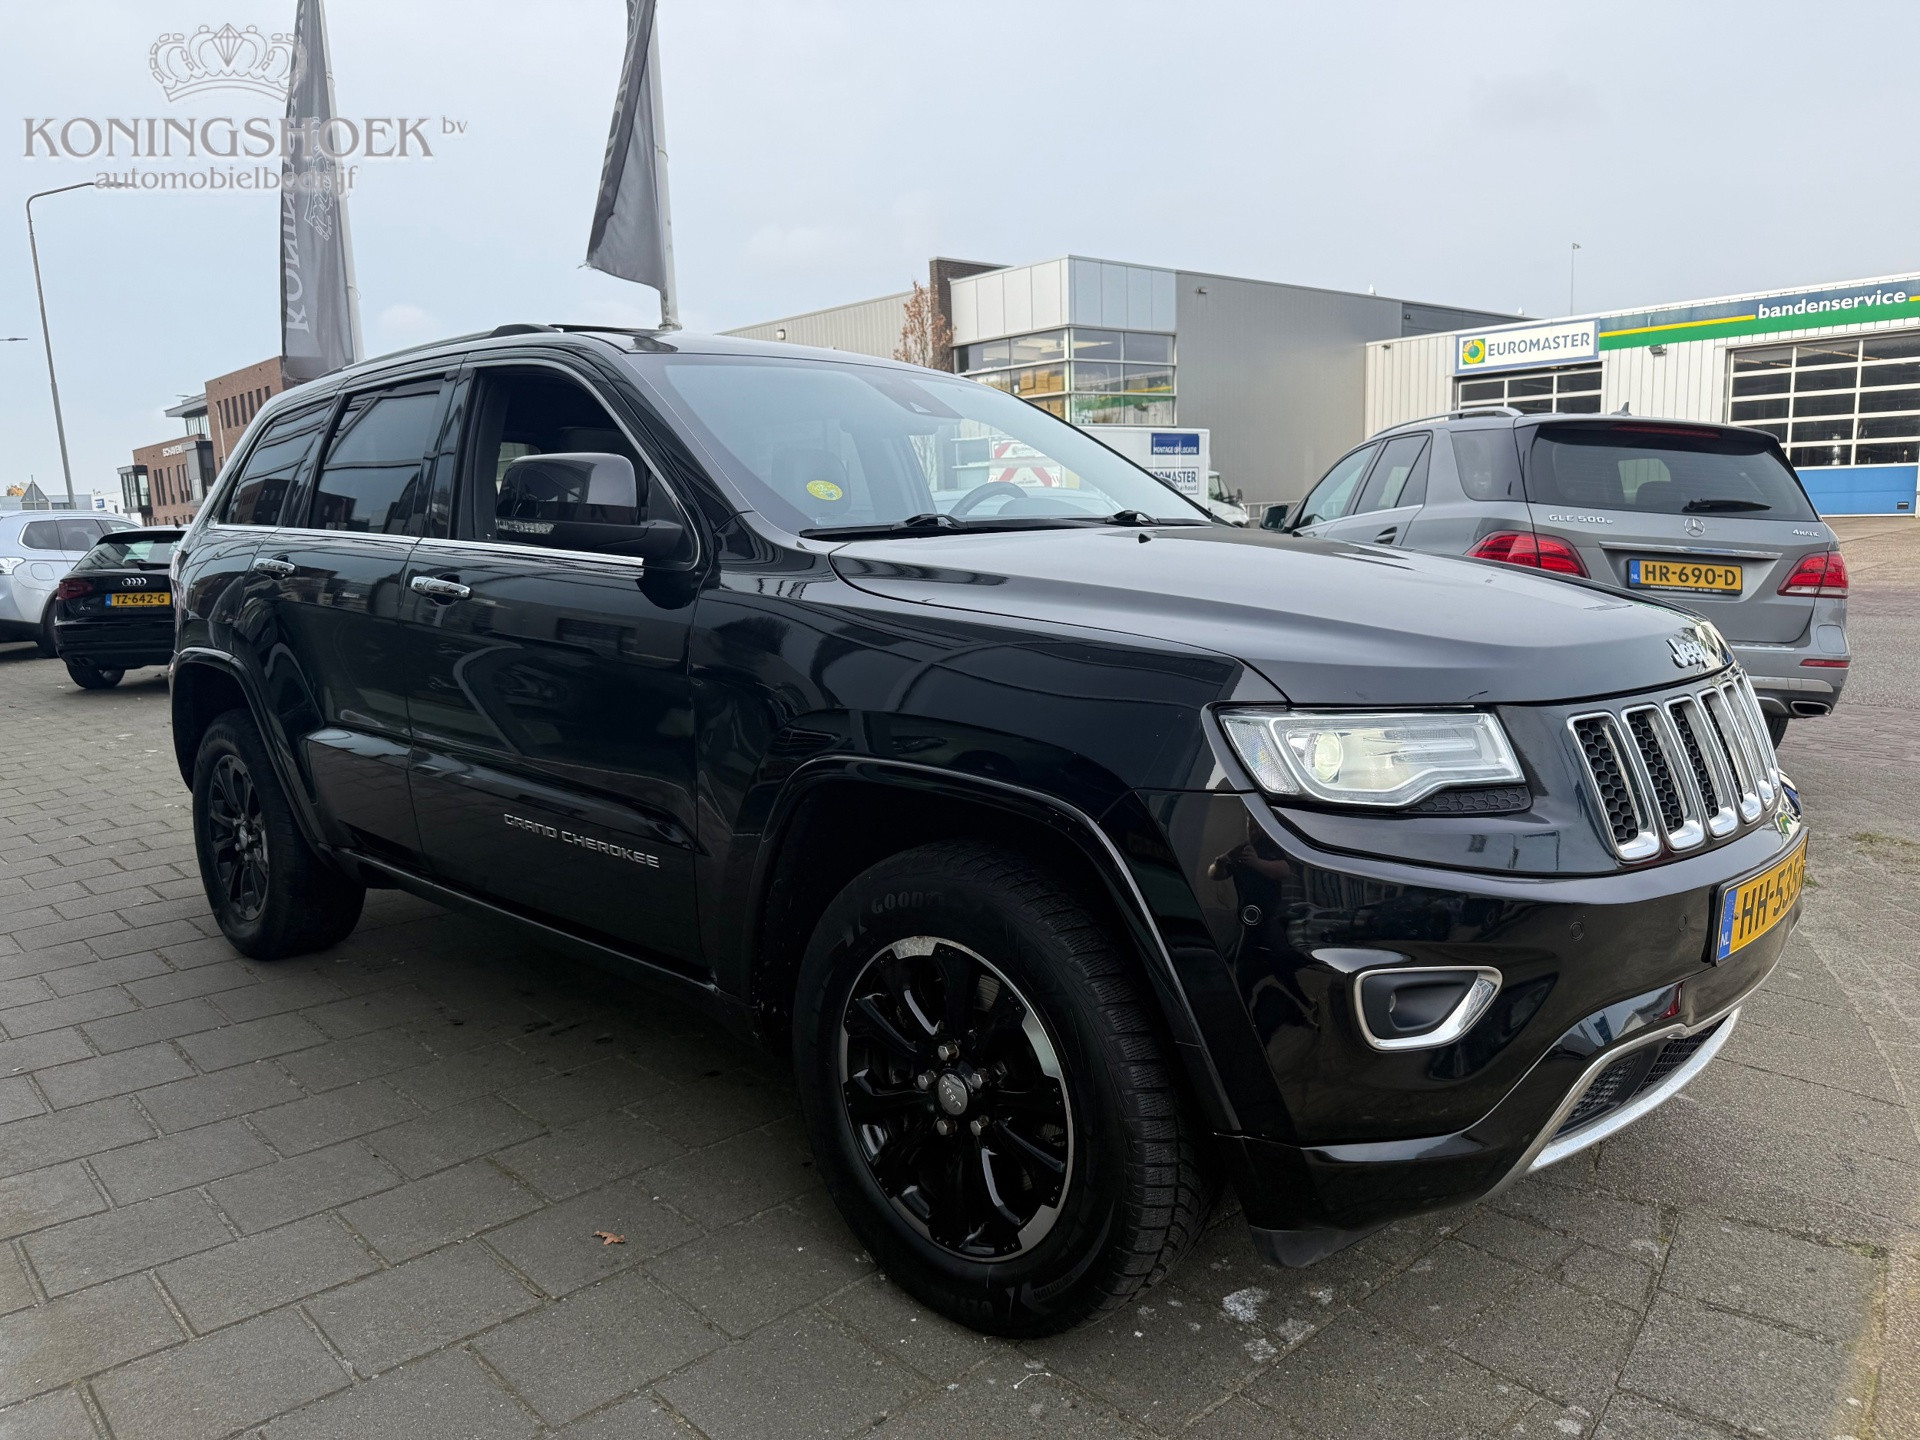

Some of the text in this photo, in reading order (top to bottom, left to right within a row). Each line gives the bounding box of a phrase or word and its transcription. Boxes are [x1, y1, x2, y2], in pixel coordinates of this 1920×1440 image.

[1758, 289, 1907, 319] bandenservice
[1488, 332, 1590, 356] EUROMASTER
[1549, 514, 1574, 522] GLE
[1645, 564, 1737, 587] HR-690-D
[115, 594, 165, 604] TZ-642-G
[1666, 638, 1710, 669] Jeep
[504, 813, 660, 868] GRAND CHEROKEE
